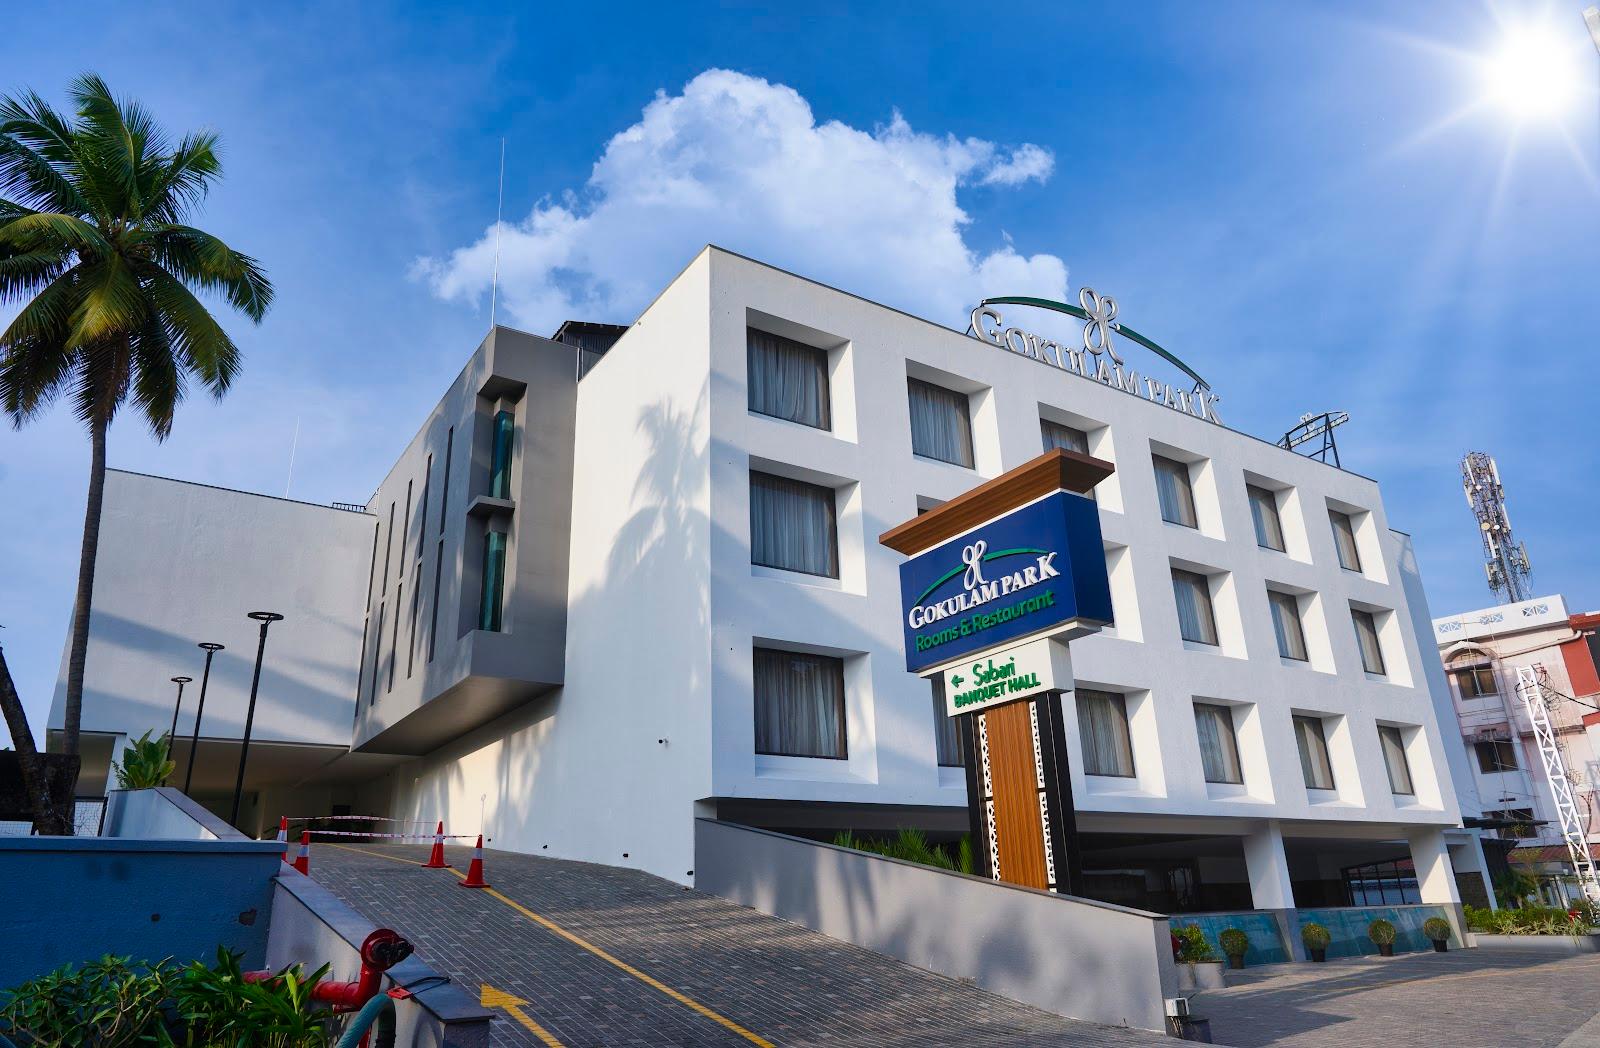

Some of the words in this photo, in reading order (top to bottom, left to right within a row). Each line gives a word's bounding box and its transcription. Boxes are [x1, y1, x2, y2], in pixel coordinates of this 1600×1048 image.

[970, 306, 1143, 396] GOKULAM
[1144, 375, 1223, 425] PARK
[908, 580, 999, 629] GOKULAM
[1001, 551, 1061, 596] PARK
[916, 625, 959, 652] Rooms
[960, 619, 972, 636] &
[973, 589, 1056, 633] Restaurant
[953, 681, 1007, 709] BANQUET
[1008, 672, 1042, 694] HALL
[972, 656, 1016, 687] Sabari
